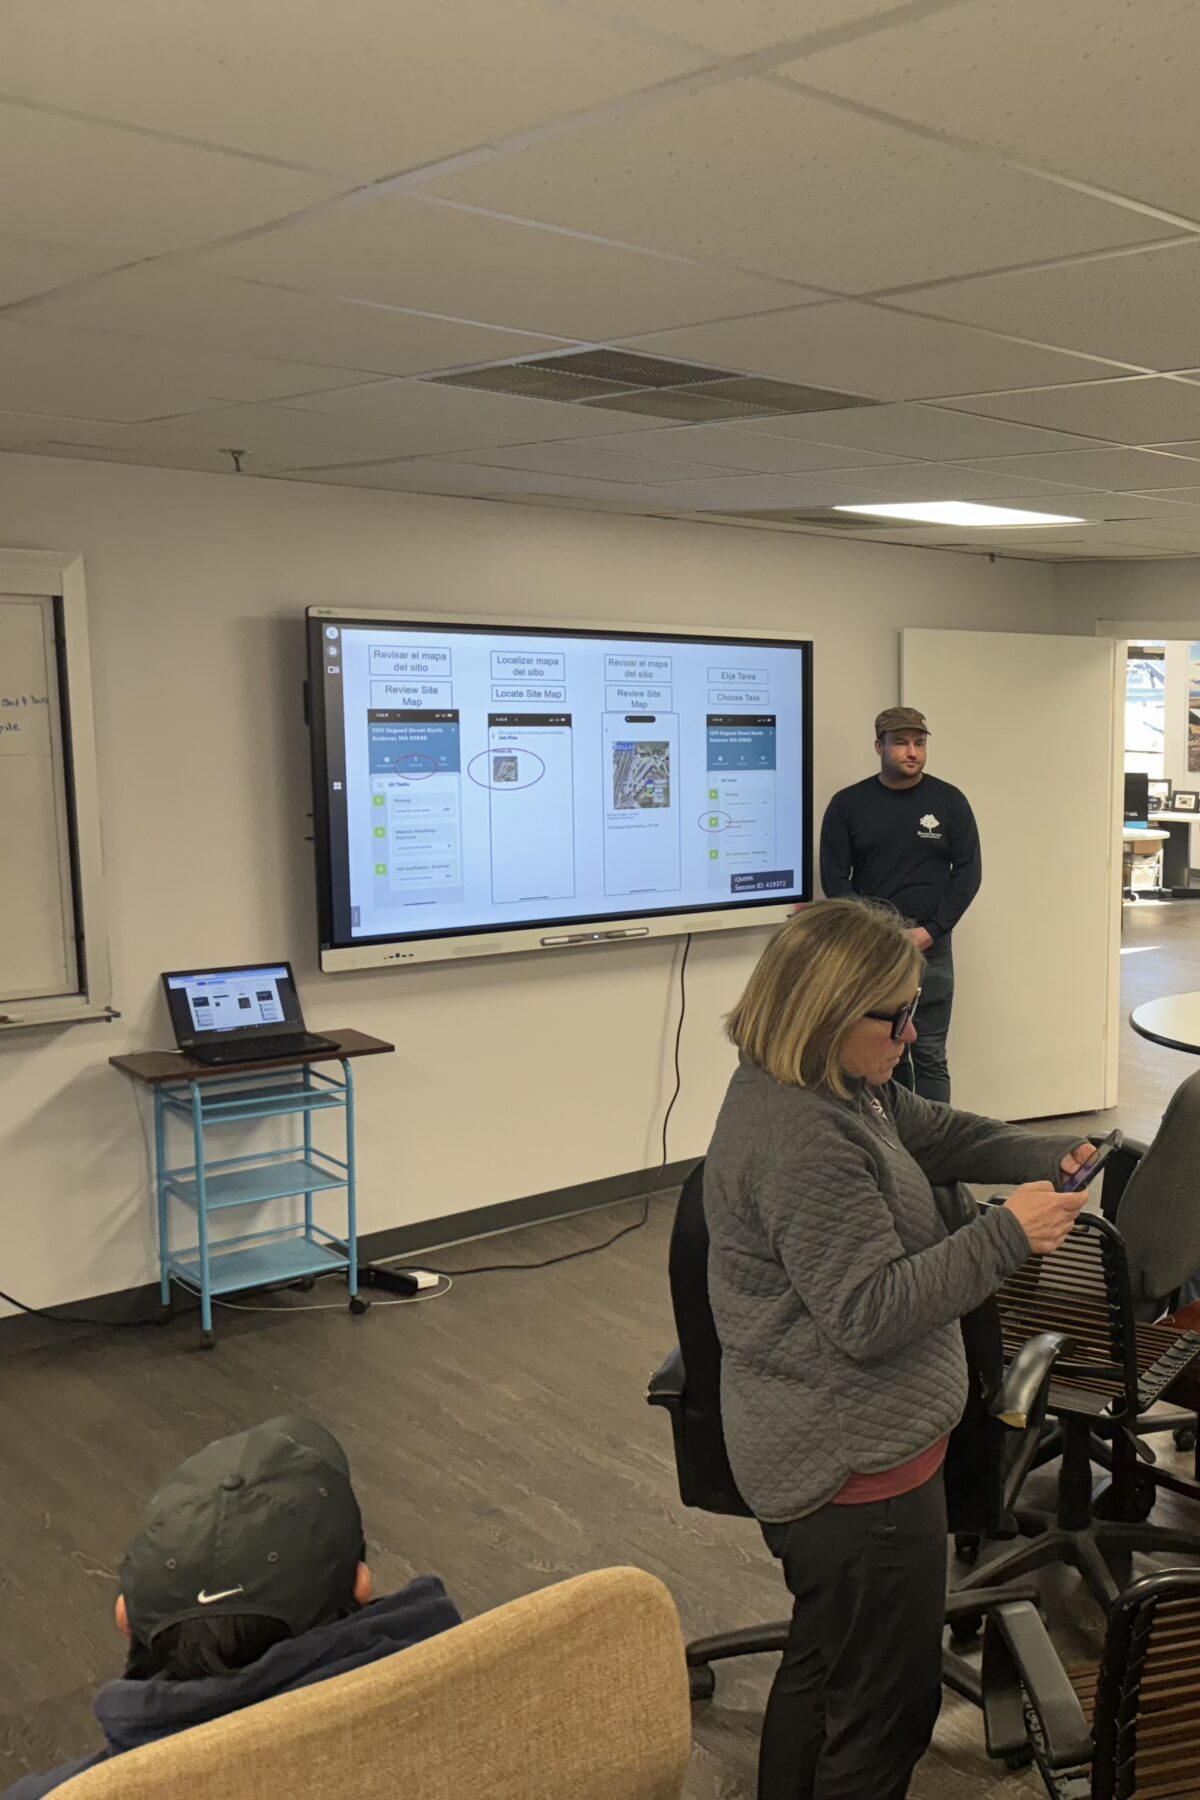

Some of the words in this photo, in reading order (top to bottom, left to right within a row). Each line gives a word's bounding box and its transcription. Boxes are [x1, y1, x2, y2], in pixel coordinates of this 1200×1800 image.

[373, 650, 408, 660] Revisar
[411, 651, 419, 660] el
[421, 652, 447, 662] mapa
[497, 656, 534, 665] Localizar
[536, 658, 559, 667] mapa
[608, 658, 637, 667] Revisar
[639, 659, 646, 667] el
[648, 660, 669, 670] mapa
[393, 663, 408, 672] del
[410, 663, 429, 673] sitio
[512, 668, 525, 676] del
[528, 668, 544, 677] sitio
[638, 671, 653, 679] sitio
[737, 672, 756, 681] Tarea
[385, 685, 418, 694] Review
[421, 685, 439, 695] Site
[495, 689, 524, 698] Locate
[526, 690, 542, 698] Site
[544, 690, 562, 700] Map
[617, 689, 644, 698] Review
[646, 690, 661, 698] Site
[717, 693, 743, 702] Choose
[744, 694, 760, 702] Task
[402, 698, 422, 707] Map
[631, 701, 648, 710] Map
[735, 883, 756, 891] Session
